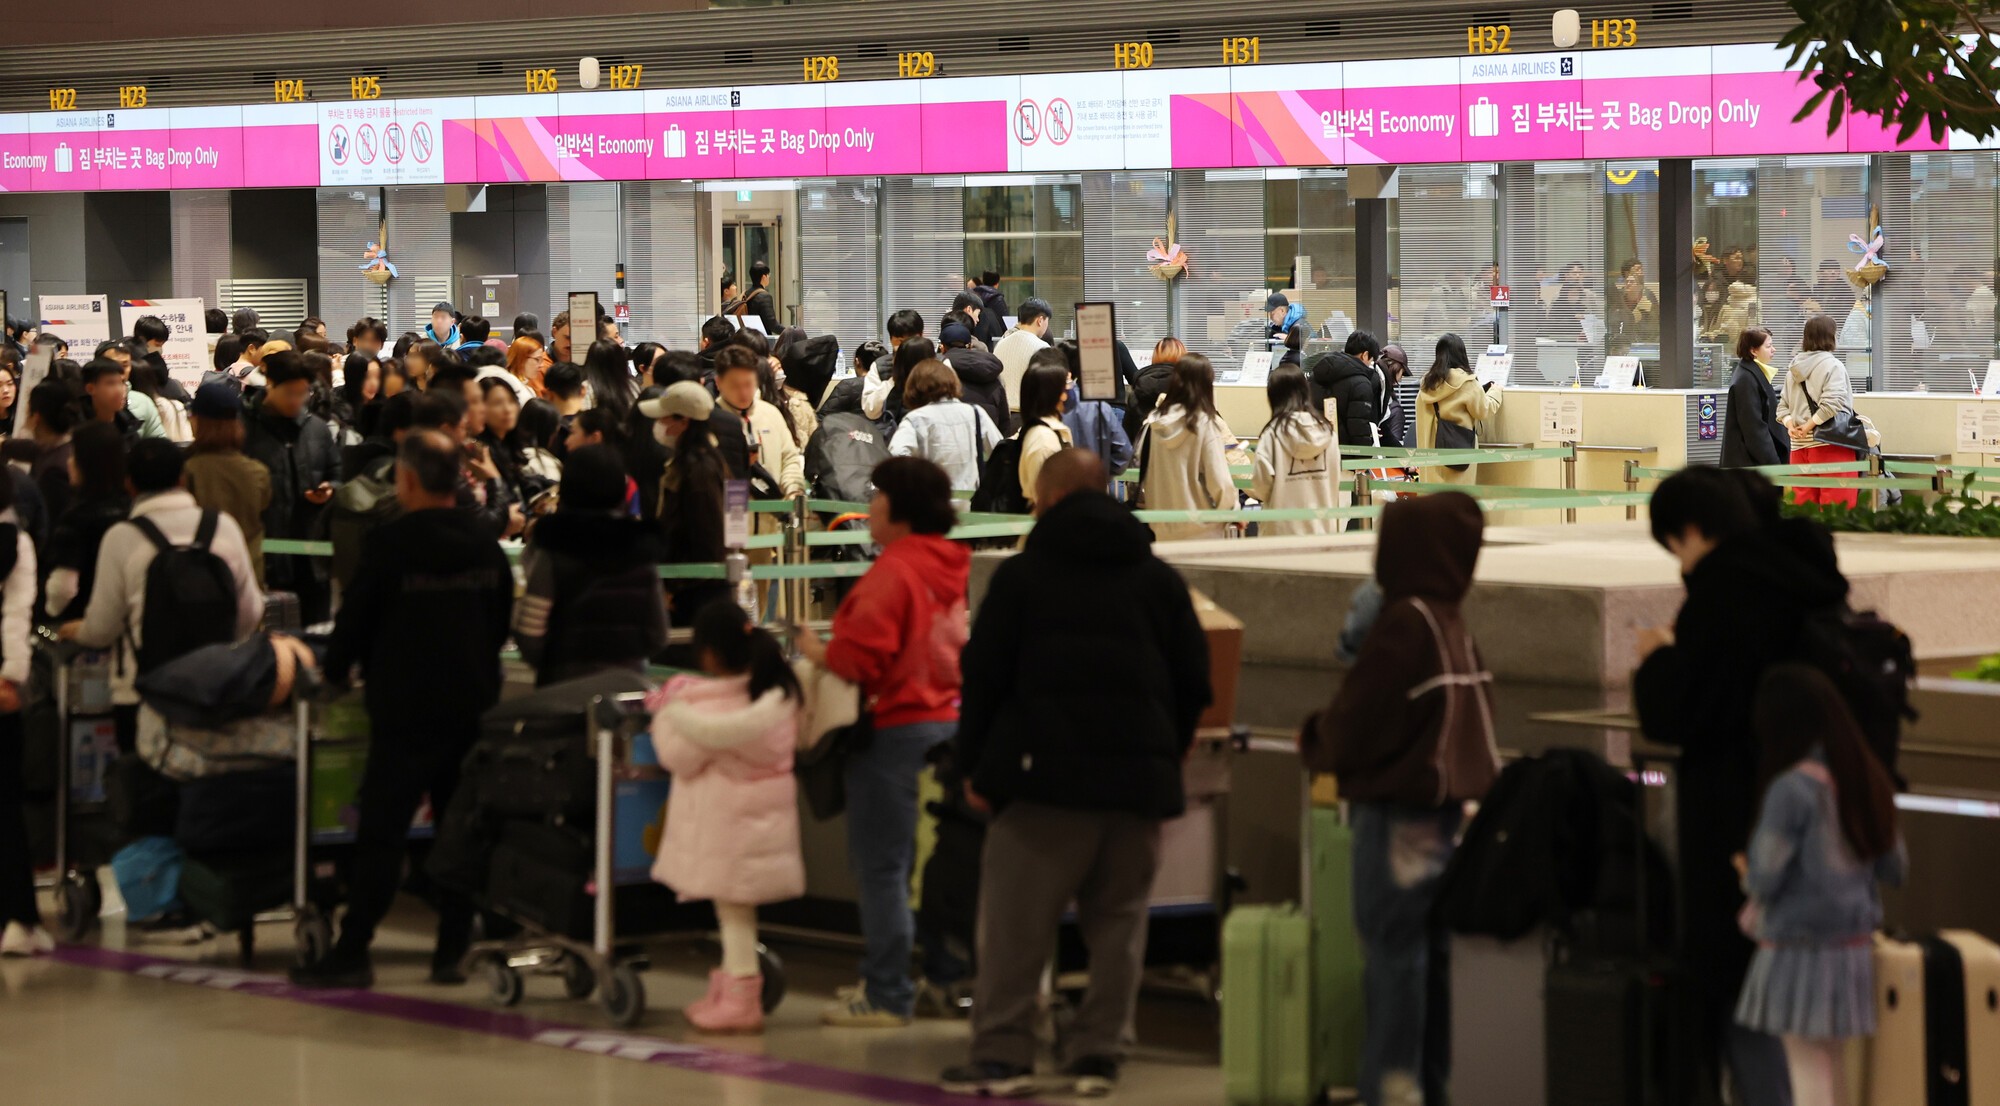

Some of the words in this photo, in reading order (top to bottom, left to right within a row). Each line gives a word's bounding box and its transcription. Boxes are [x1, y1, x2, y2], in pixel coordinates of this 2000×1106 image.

[1467, 25, 1512, 54] H32
[1591, 18, 1637, 48] H33
[1114, 42, 1154, 69] H30
[1222, 36, 1260, 64] H31
[610, 64, 643, 89] H27
[803, 56, 839, 81] H28
[898, 51, 935, 77] H29
[1472, 64, 1508, 77] ASIANA
[1512, 62, 1556, 75] AIRLINES
[274, 80, 304, 102] H24
[351, 76, 381, 100] H25
[525, 69, 558, 93] H26
[50, 88, 77, 110] H22
[120, 86, 147, 108] H23
[666, 96, 692, 107] ASIANA
[694, 94, 728, 106] AIRLINES
[56, 117, 77, 128] ASIANA
[79, 116, 105, 127] AIRLINES
[1320, 108, 1374, 138] 일반석
[1380, 110, 1455, 137] Economy
[1511, 103, 1530, 133] 짐
[1536, 101, 1594, 132] 부치는
[1600, 100, 1621, 131] 곳
[1629, 103, 1662, 131] Bag
[1668, 101, 1712, 128] Drop
[1718, 98, 1760, 128] Only
[554, 132, 594, 158] 일반석
[599, 135, 654, 158] Economy
[695, 130, 709, 155] 짐
[713, 128, 756, 155] 부치는
[760, 128, 776, 154] 곳
[780, 130, 805, 154] Bag
[809, 129, 840, 154] Drop
[844, 127, 875, 152] Only
[3, 152, 47, 173] Economy
[79, 149, 91, 170] 짐
[94, 147, 127, 170] 부치는
[130, 147, 142, 169] 곳
[146, 149, 165, 170] Bag
[168, 147, 192, 169] Drop
[195, 146, 219, 168] Only
[176, 324, 193, 334] 안내
